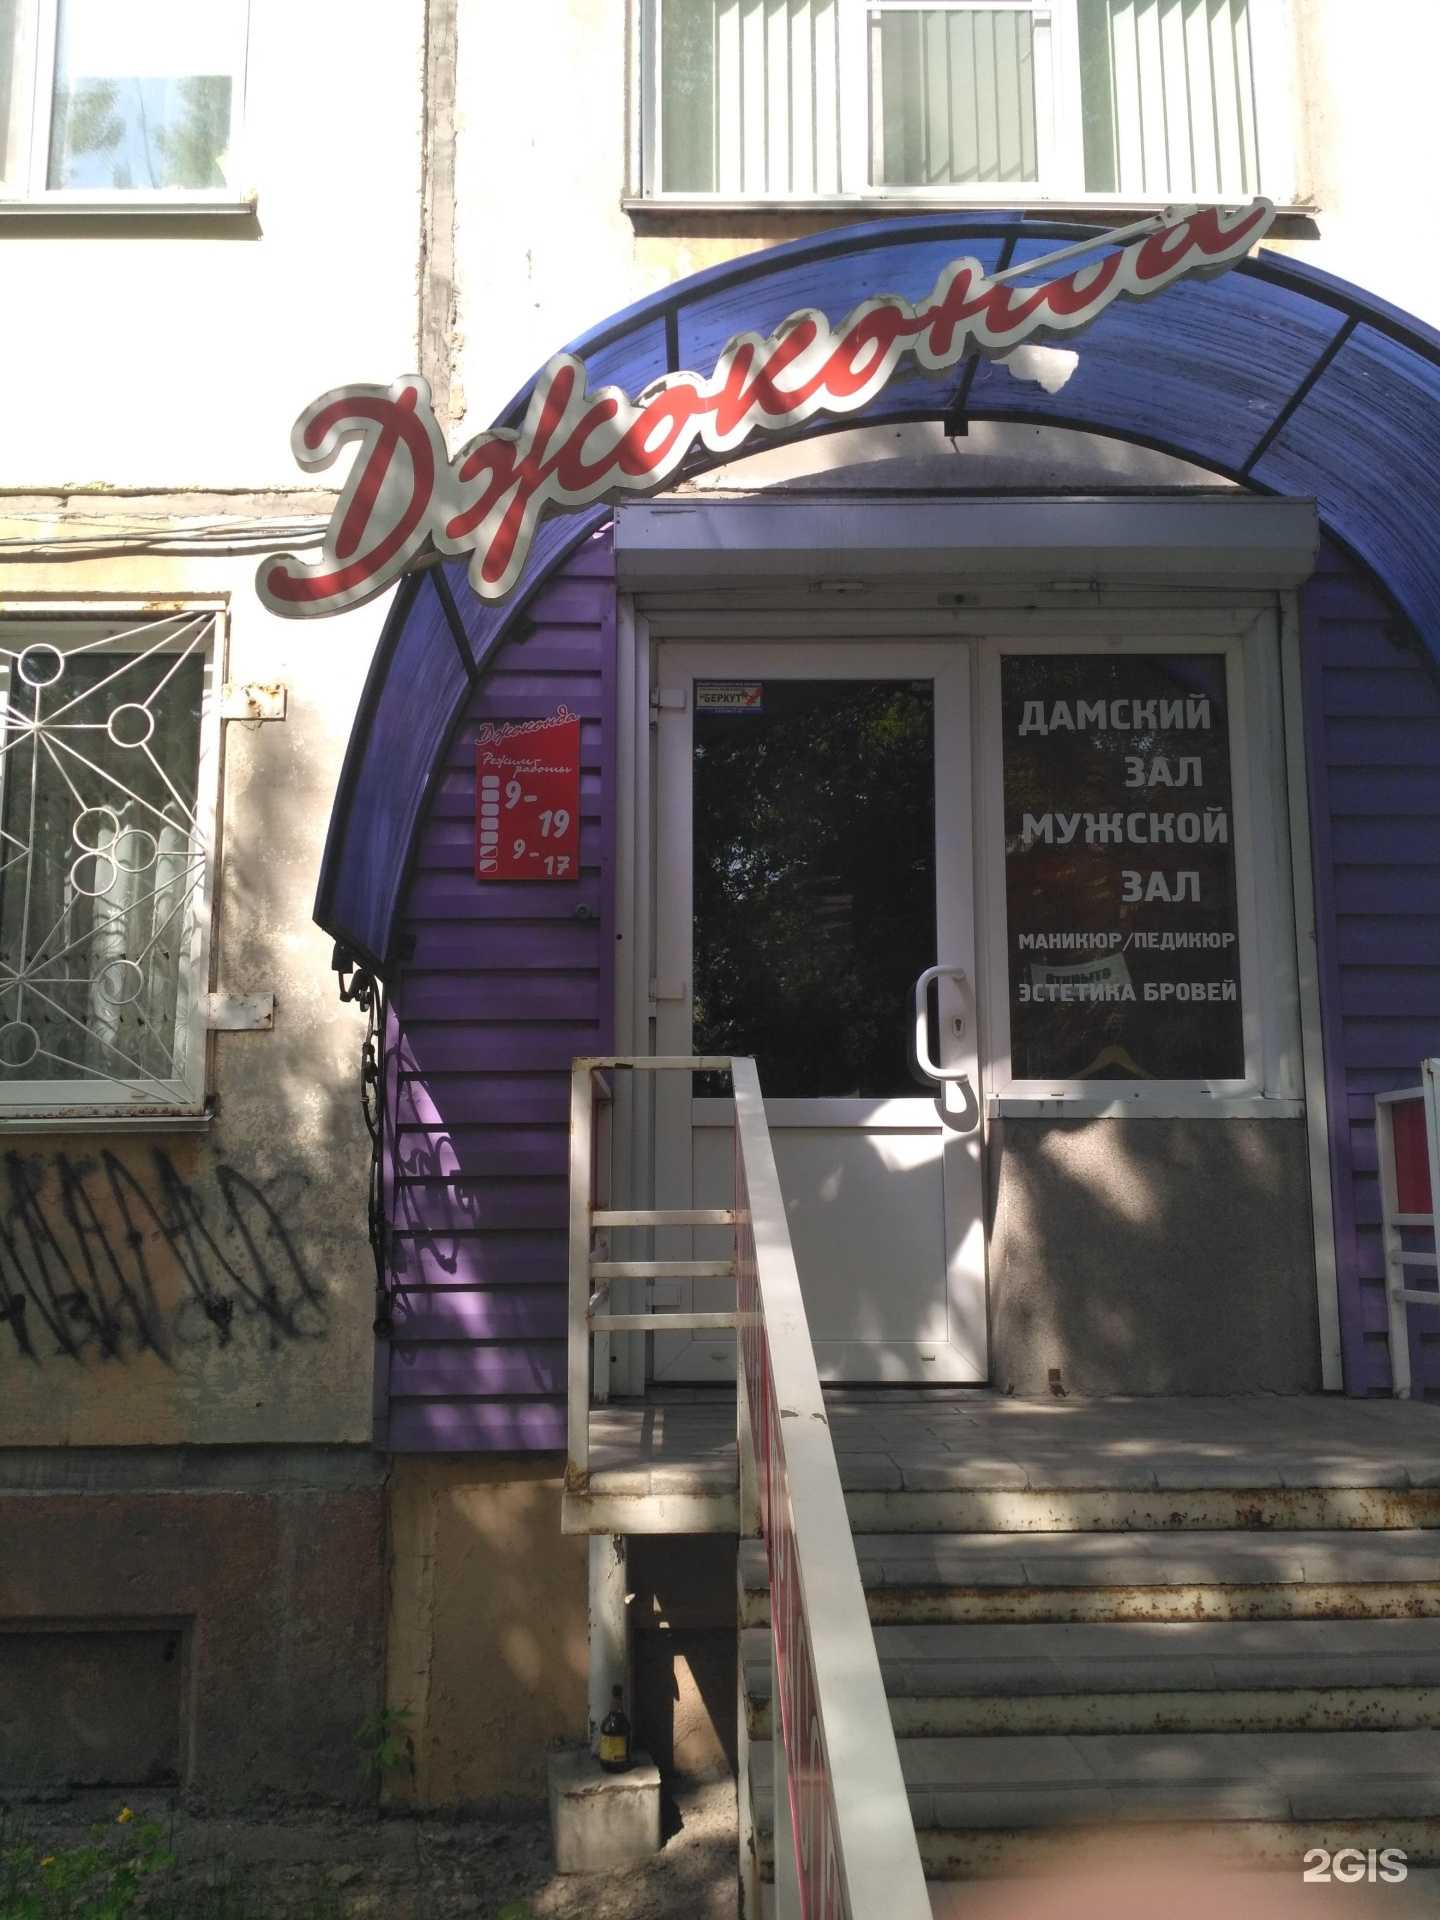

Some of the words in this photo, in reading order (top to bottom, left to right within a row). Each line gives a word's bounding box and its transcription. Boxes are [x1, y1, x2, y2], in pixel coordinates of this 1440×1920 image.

[1018, 694, 1211, 736] ДАМСКИЙ
[1124, 756, 1203, 788] ЗАЛ
[538, 809, 570, 838] 19
[1021, 806, 1228, 844] МУЖСКОЙ
[544, 856, 570, 875] 17
[1121, 870, 1201, 902] ЗАЛ
[1018, 982, 1136, 1003] ЭСТЕТИКА
[1143, 979, 1237, 1002] БРОВЕЙ
